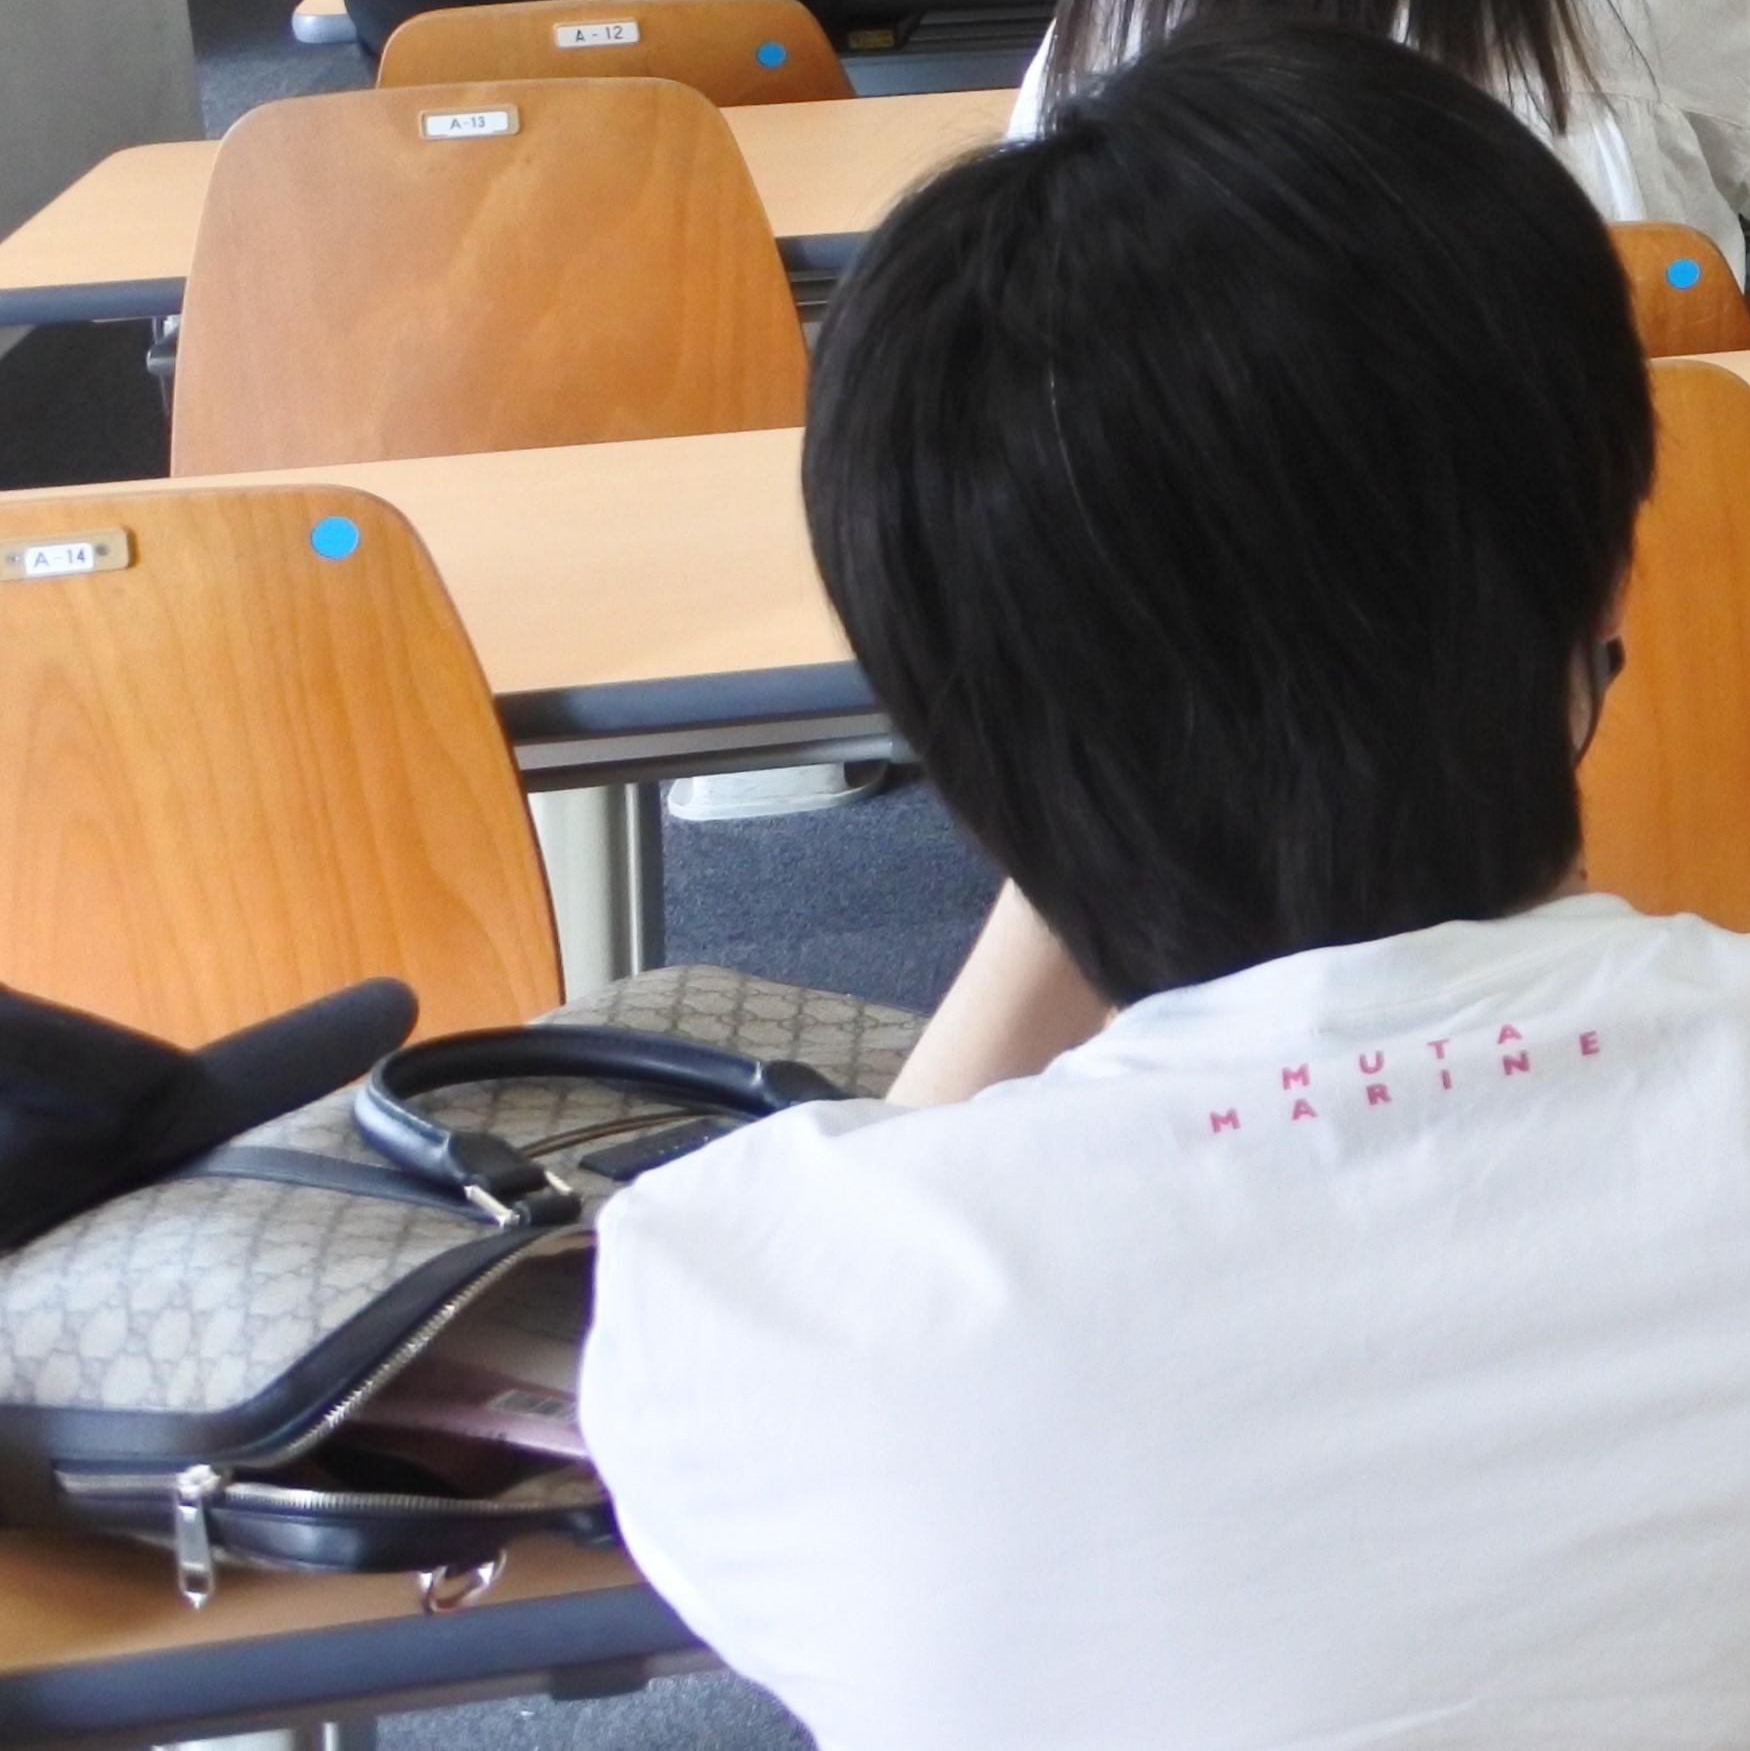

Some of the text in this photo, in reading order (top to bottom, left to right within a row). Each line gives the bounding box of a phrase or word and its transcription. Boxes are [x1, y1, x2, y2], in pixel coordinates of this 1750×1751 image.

[449, 115, 486, 131] A-13
[33, 547, 86, 568] A-14
[1280, 1022, 1523, 1092] MUTA
[1210, 1030, 1601, 1134] MARINE
